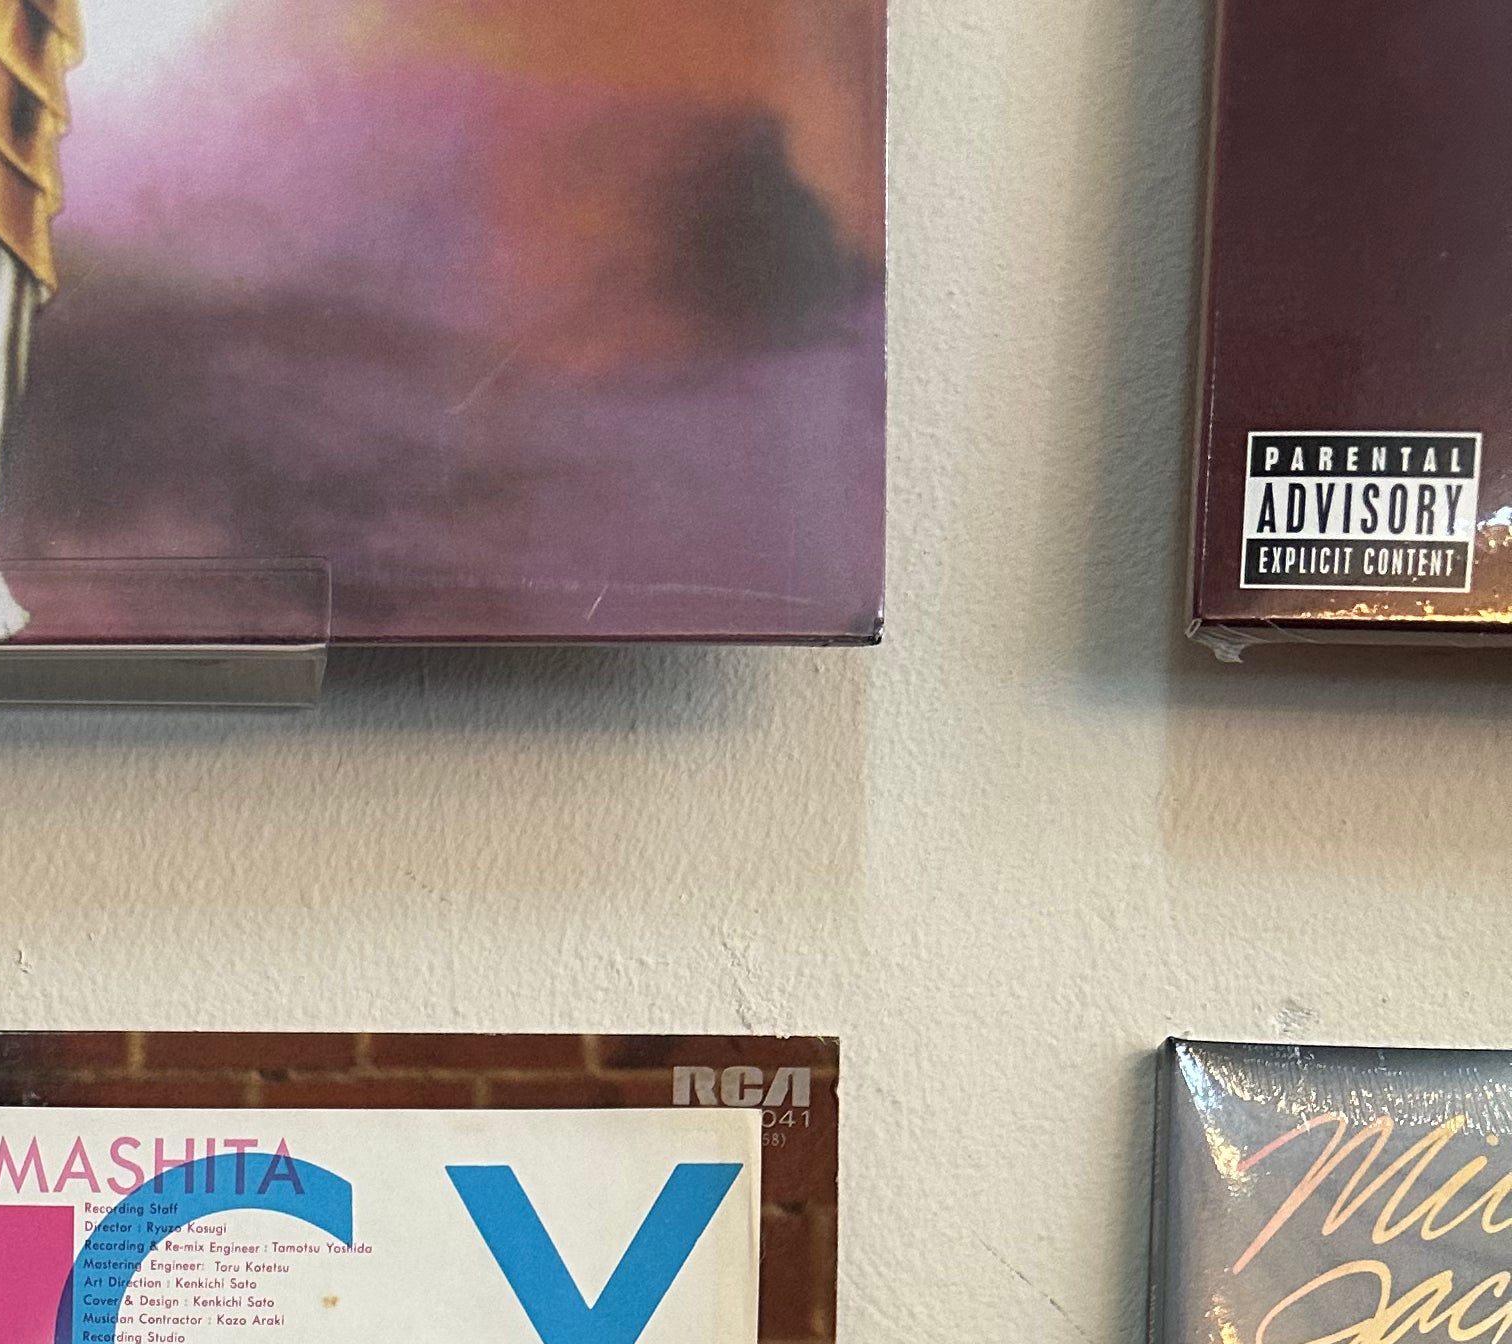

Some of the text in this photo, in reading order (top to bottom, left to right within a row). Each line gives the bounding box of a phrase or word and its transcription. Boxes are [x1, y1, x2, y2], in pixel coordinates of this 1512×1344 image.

[1264, 446, 1462, 473] PARENTAL
[1257, 482, 1463, 536] ADVISORY
[1258, 547, 1454, 577] EXPLICIT CONTENT
[673, 1066, 810, 1107] RCA
[85, 1202, 178, 1217] Recording Staff
[85, 1222, 227, 1236] Director Ryuzo Kosugi
[85, 1240, 144, 1252] Recording
[166, 1241, 204, 1252] Re-mix
[210, 1242, 259, 1255] Engineer
[272, 1242, 320, 1254] Tamotsu
[326, 1242, 372, 1254] Yoshida
[83, 1260, 141, 1272] Mastering
[215, 1262, 240, 1273] Toru
[84, 1277, 256, 1289] Art Direction Kenkichi Sato
[83, 1295, 274, 1309] Cover & Design Kenkichi Sato
[83, 1332, 185, 1344] Recording Studio
